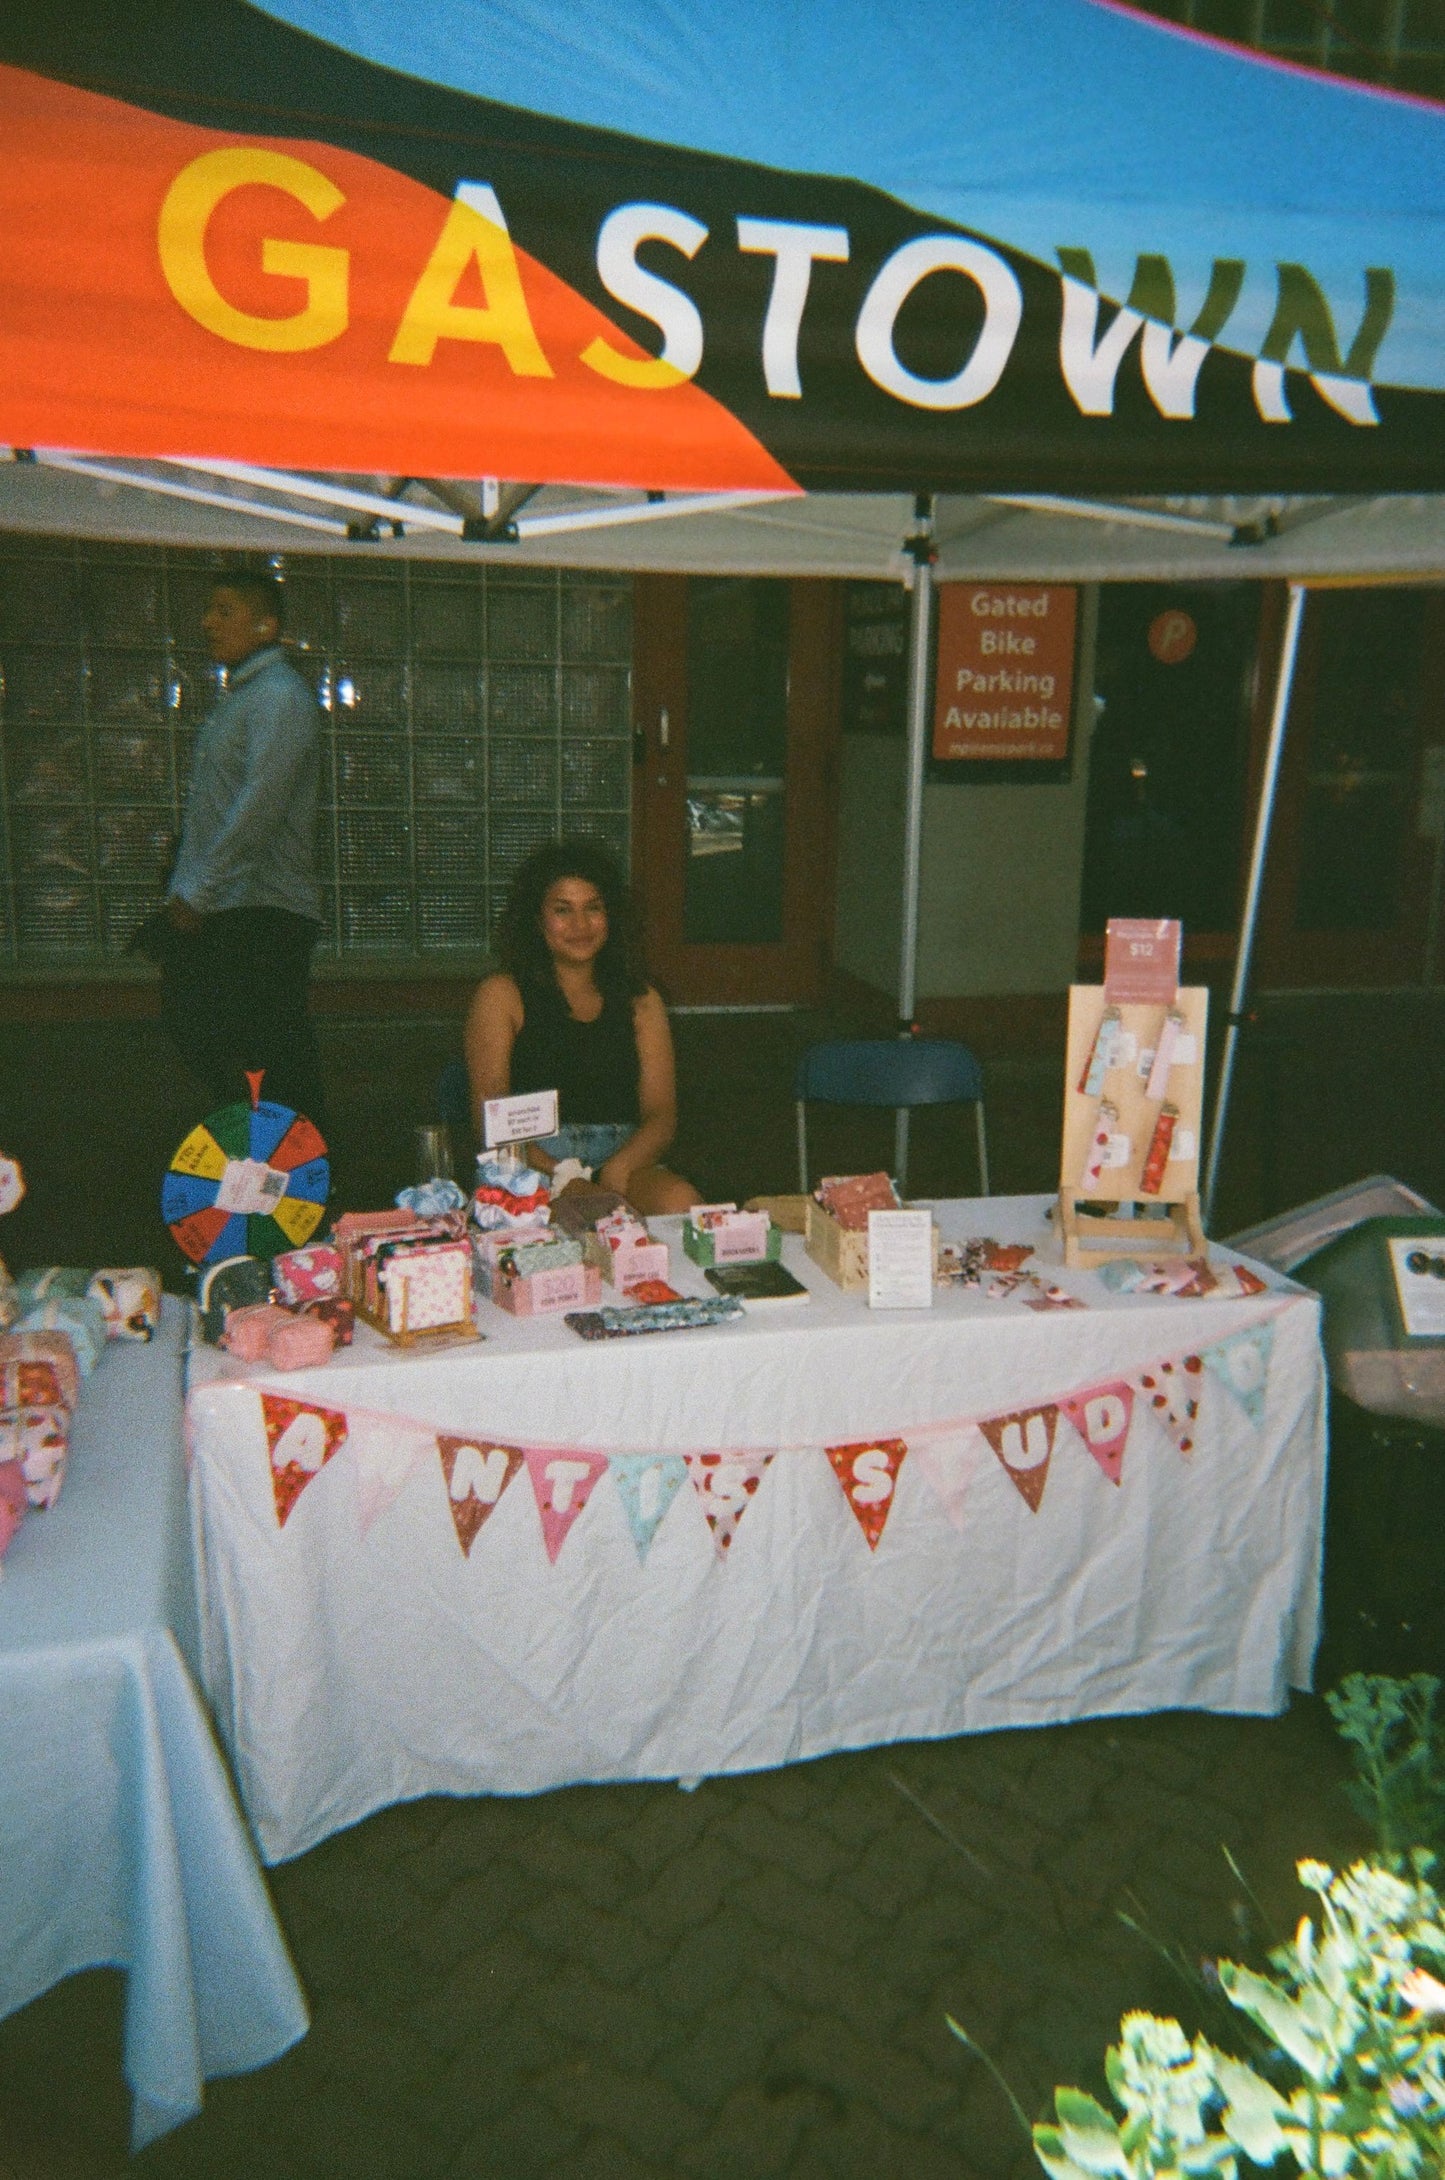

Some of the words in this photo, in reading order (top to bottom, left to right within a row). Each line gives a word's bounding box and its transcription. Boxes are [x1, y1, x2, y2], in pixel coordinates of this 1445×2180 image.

[157, 145, 1393, 427] GASTOWN
[970, 591, 1049, 618] Gated
[980, 630, 1037, 656] Bike
[1161, 617, 1188, 652] P
[956, 668, 1055, 700] Parking
[944, 706, 1063, 731] Available
[1129, 942, 1154, 957] $12
